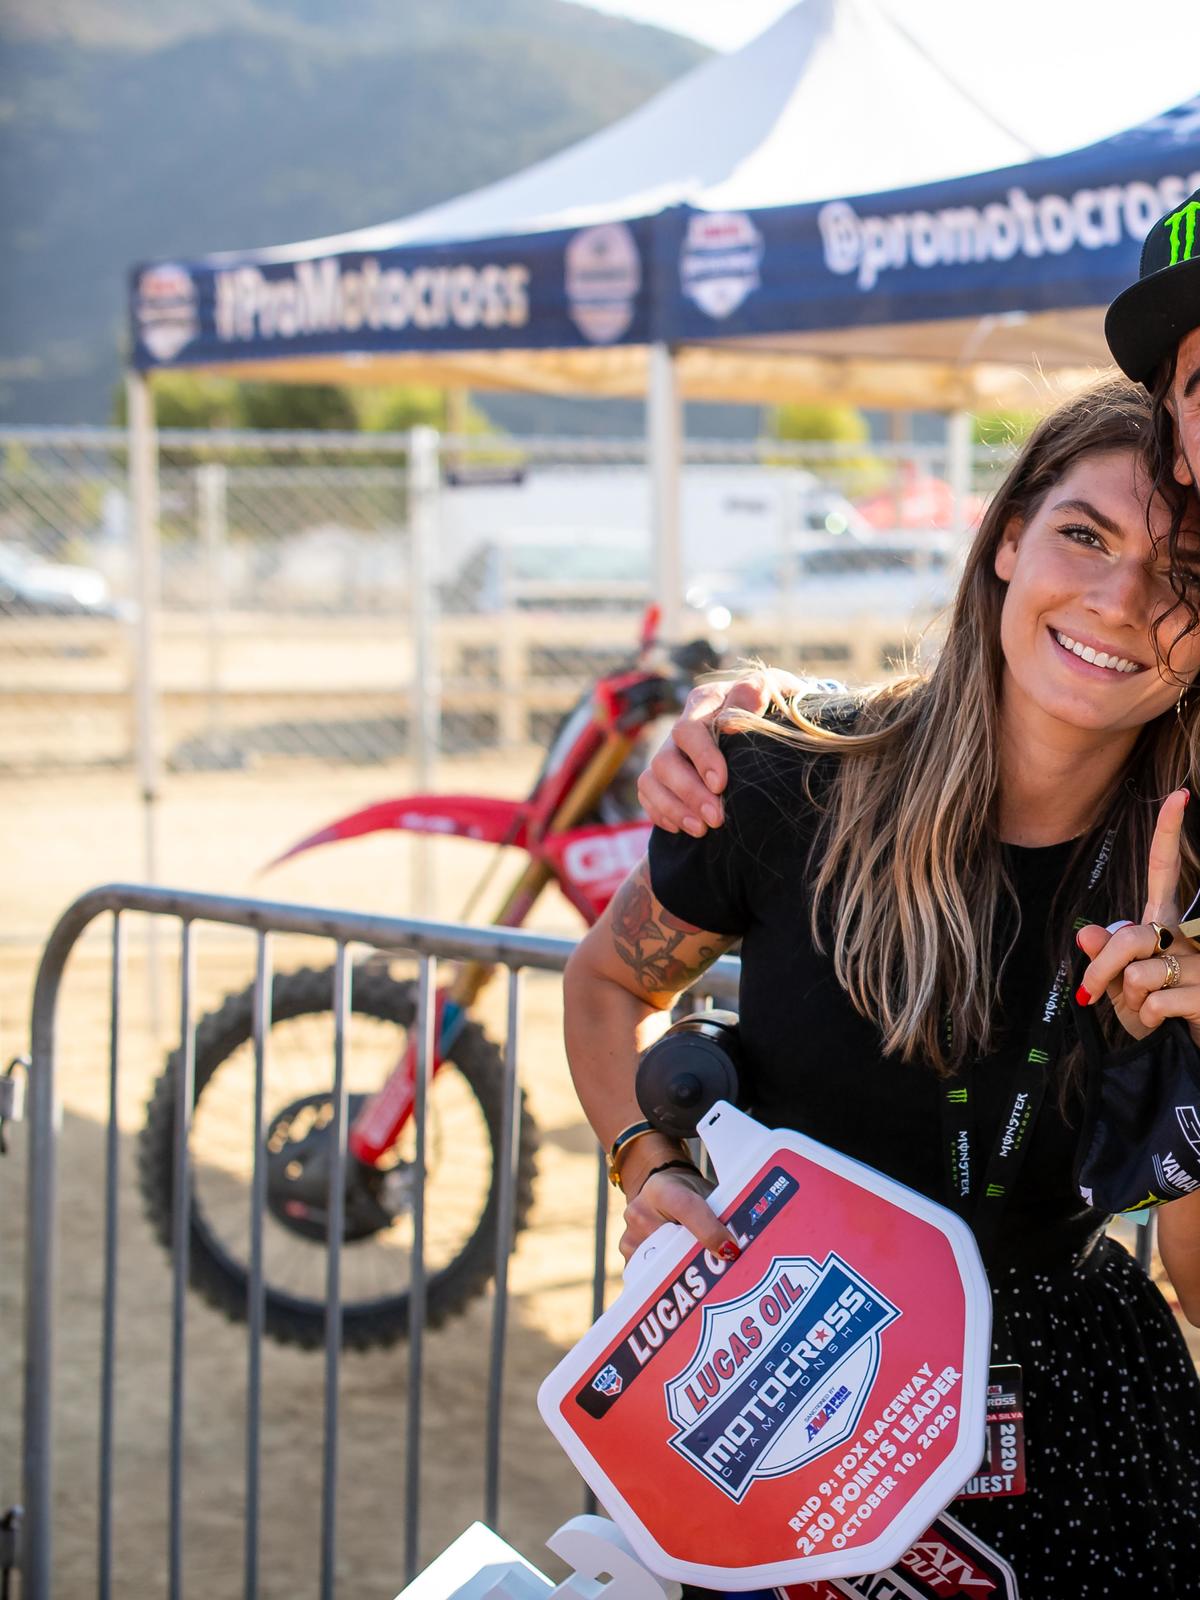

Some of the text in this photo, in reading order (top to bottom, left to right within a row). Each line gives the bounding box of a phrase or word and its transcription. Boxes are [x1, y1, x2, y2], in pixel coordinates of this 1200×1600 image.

[213, 255, 530, 342] #ProMotocross
[627, 1264, 708, 1367] LUCAS
[684, 1272, 805, 1415] LUCAS OIL
[702, 1284, 866, 1473] MOTOCROSS
[750, 1341, 792, 1390] PRO
[720, 1300, 874, 1478] CHAMPIONSHIP
[788, 1362, 933, 1533] RND 9: FOX RACEWAY
[805, 1385, 849, 1443] AMA PRO
[1000, 1423, 1017, 1471] 2020
[796, 1512, 835, 1556] 250
[830, 1439, 898, 1516] POINTS
[891, 1366, 962, 1443] LEADER
[832, 1405, 957, 1549] OCTOBER 10, 2020
